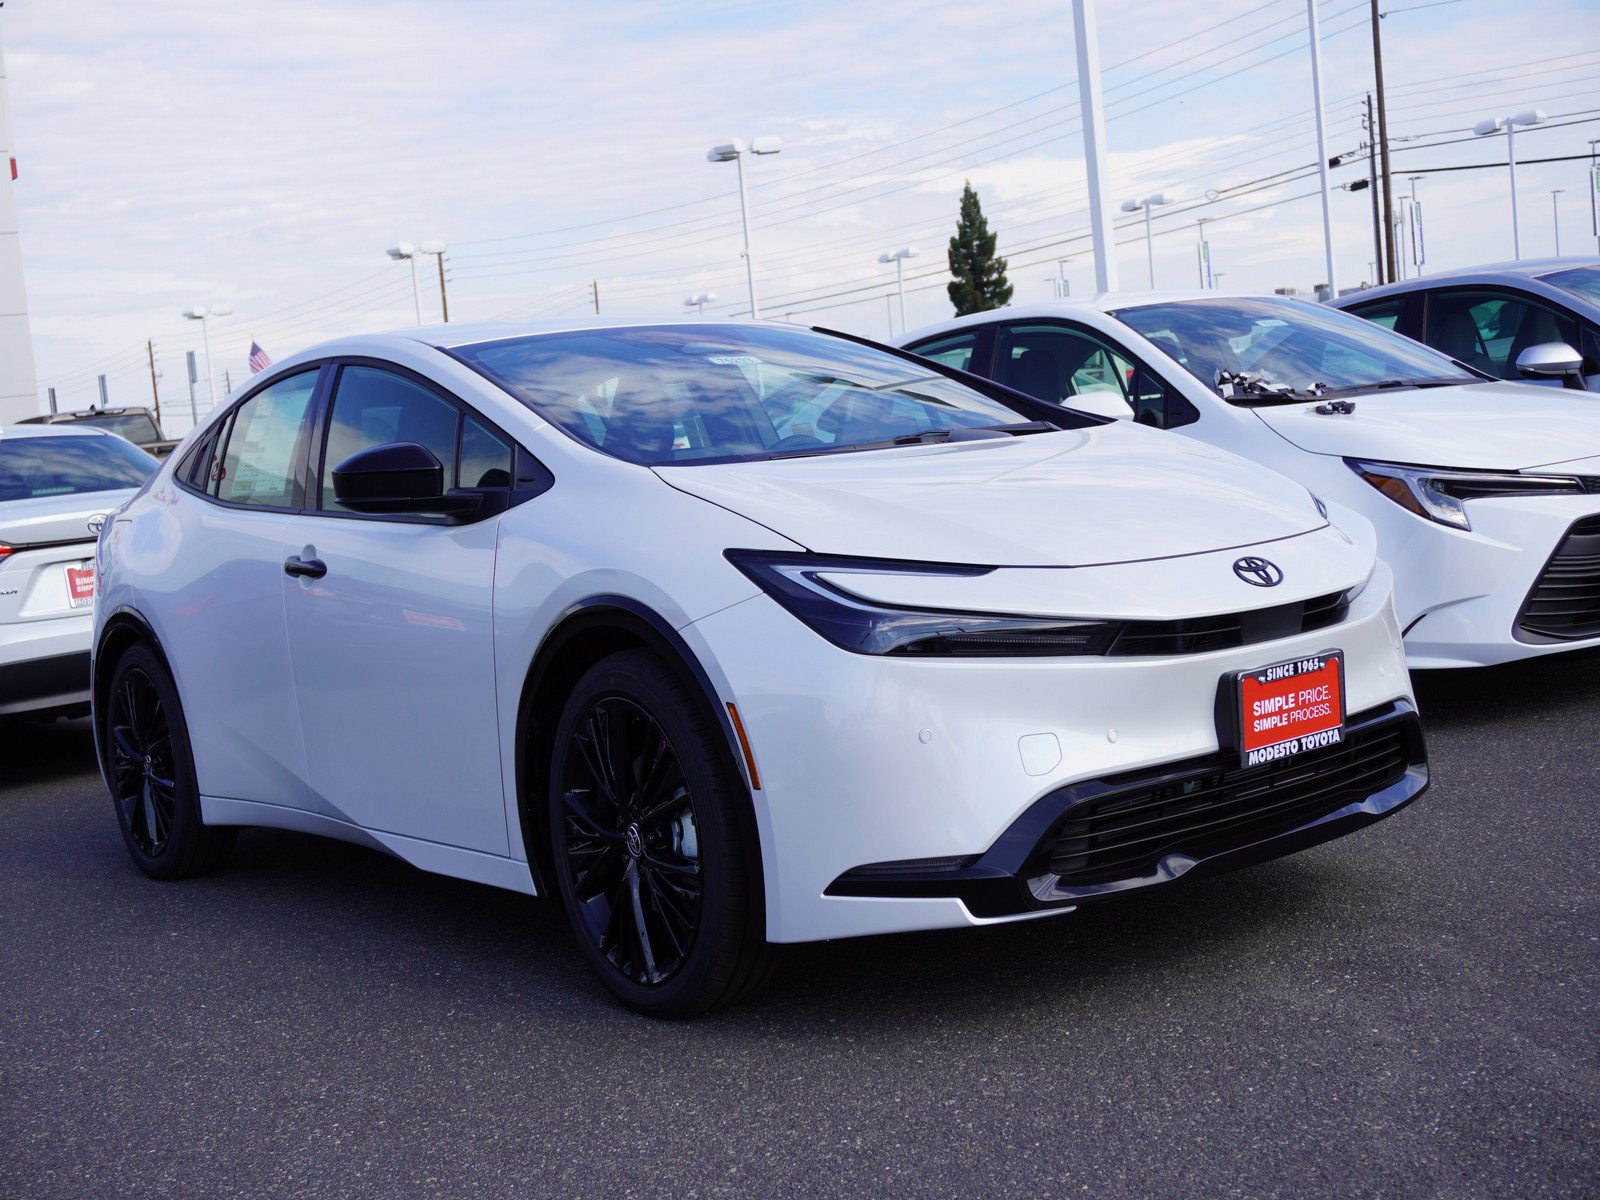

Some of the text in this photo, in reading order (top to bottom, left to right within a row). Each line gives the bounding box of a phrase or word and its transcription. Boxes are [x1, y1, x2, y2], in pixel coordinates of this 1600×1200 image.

[1266, 658, 1319, 681] SINCE 1965
[1253, 685, 1332, 717] SIMPLE PRICE.
[1253, 703, 1332, 733] SIMPLE PROCESS.
[1248, 729, 1341, 766] MODESTO TOYOTA
